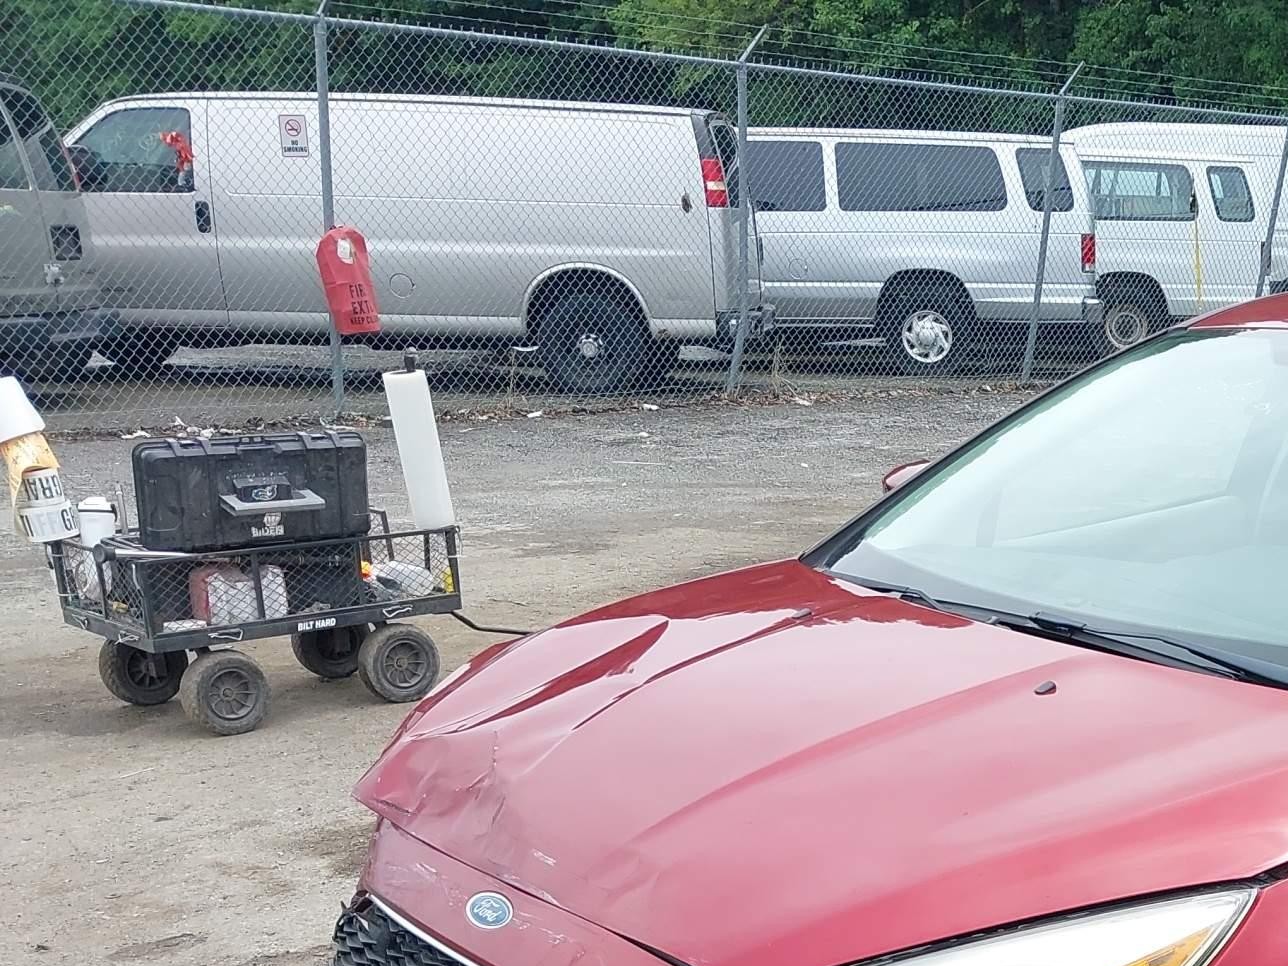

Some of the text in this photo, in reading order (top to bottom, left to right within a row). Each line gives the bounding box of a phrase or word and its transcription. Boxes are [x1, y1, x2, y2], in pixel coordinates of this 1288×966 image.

[297, 617, 337, 632] BILT HARD
[473, 898, 503, 922] Ford
